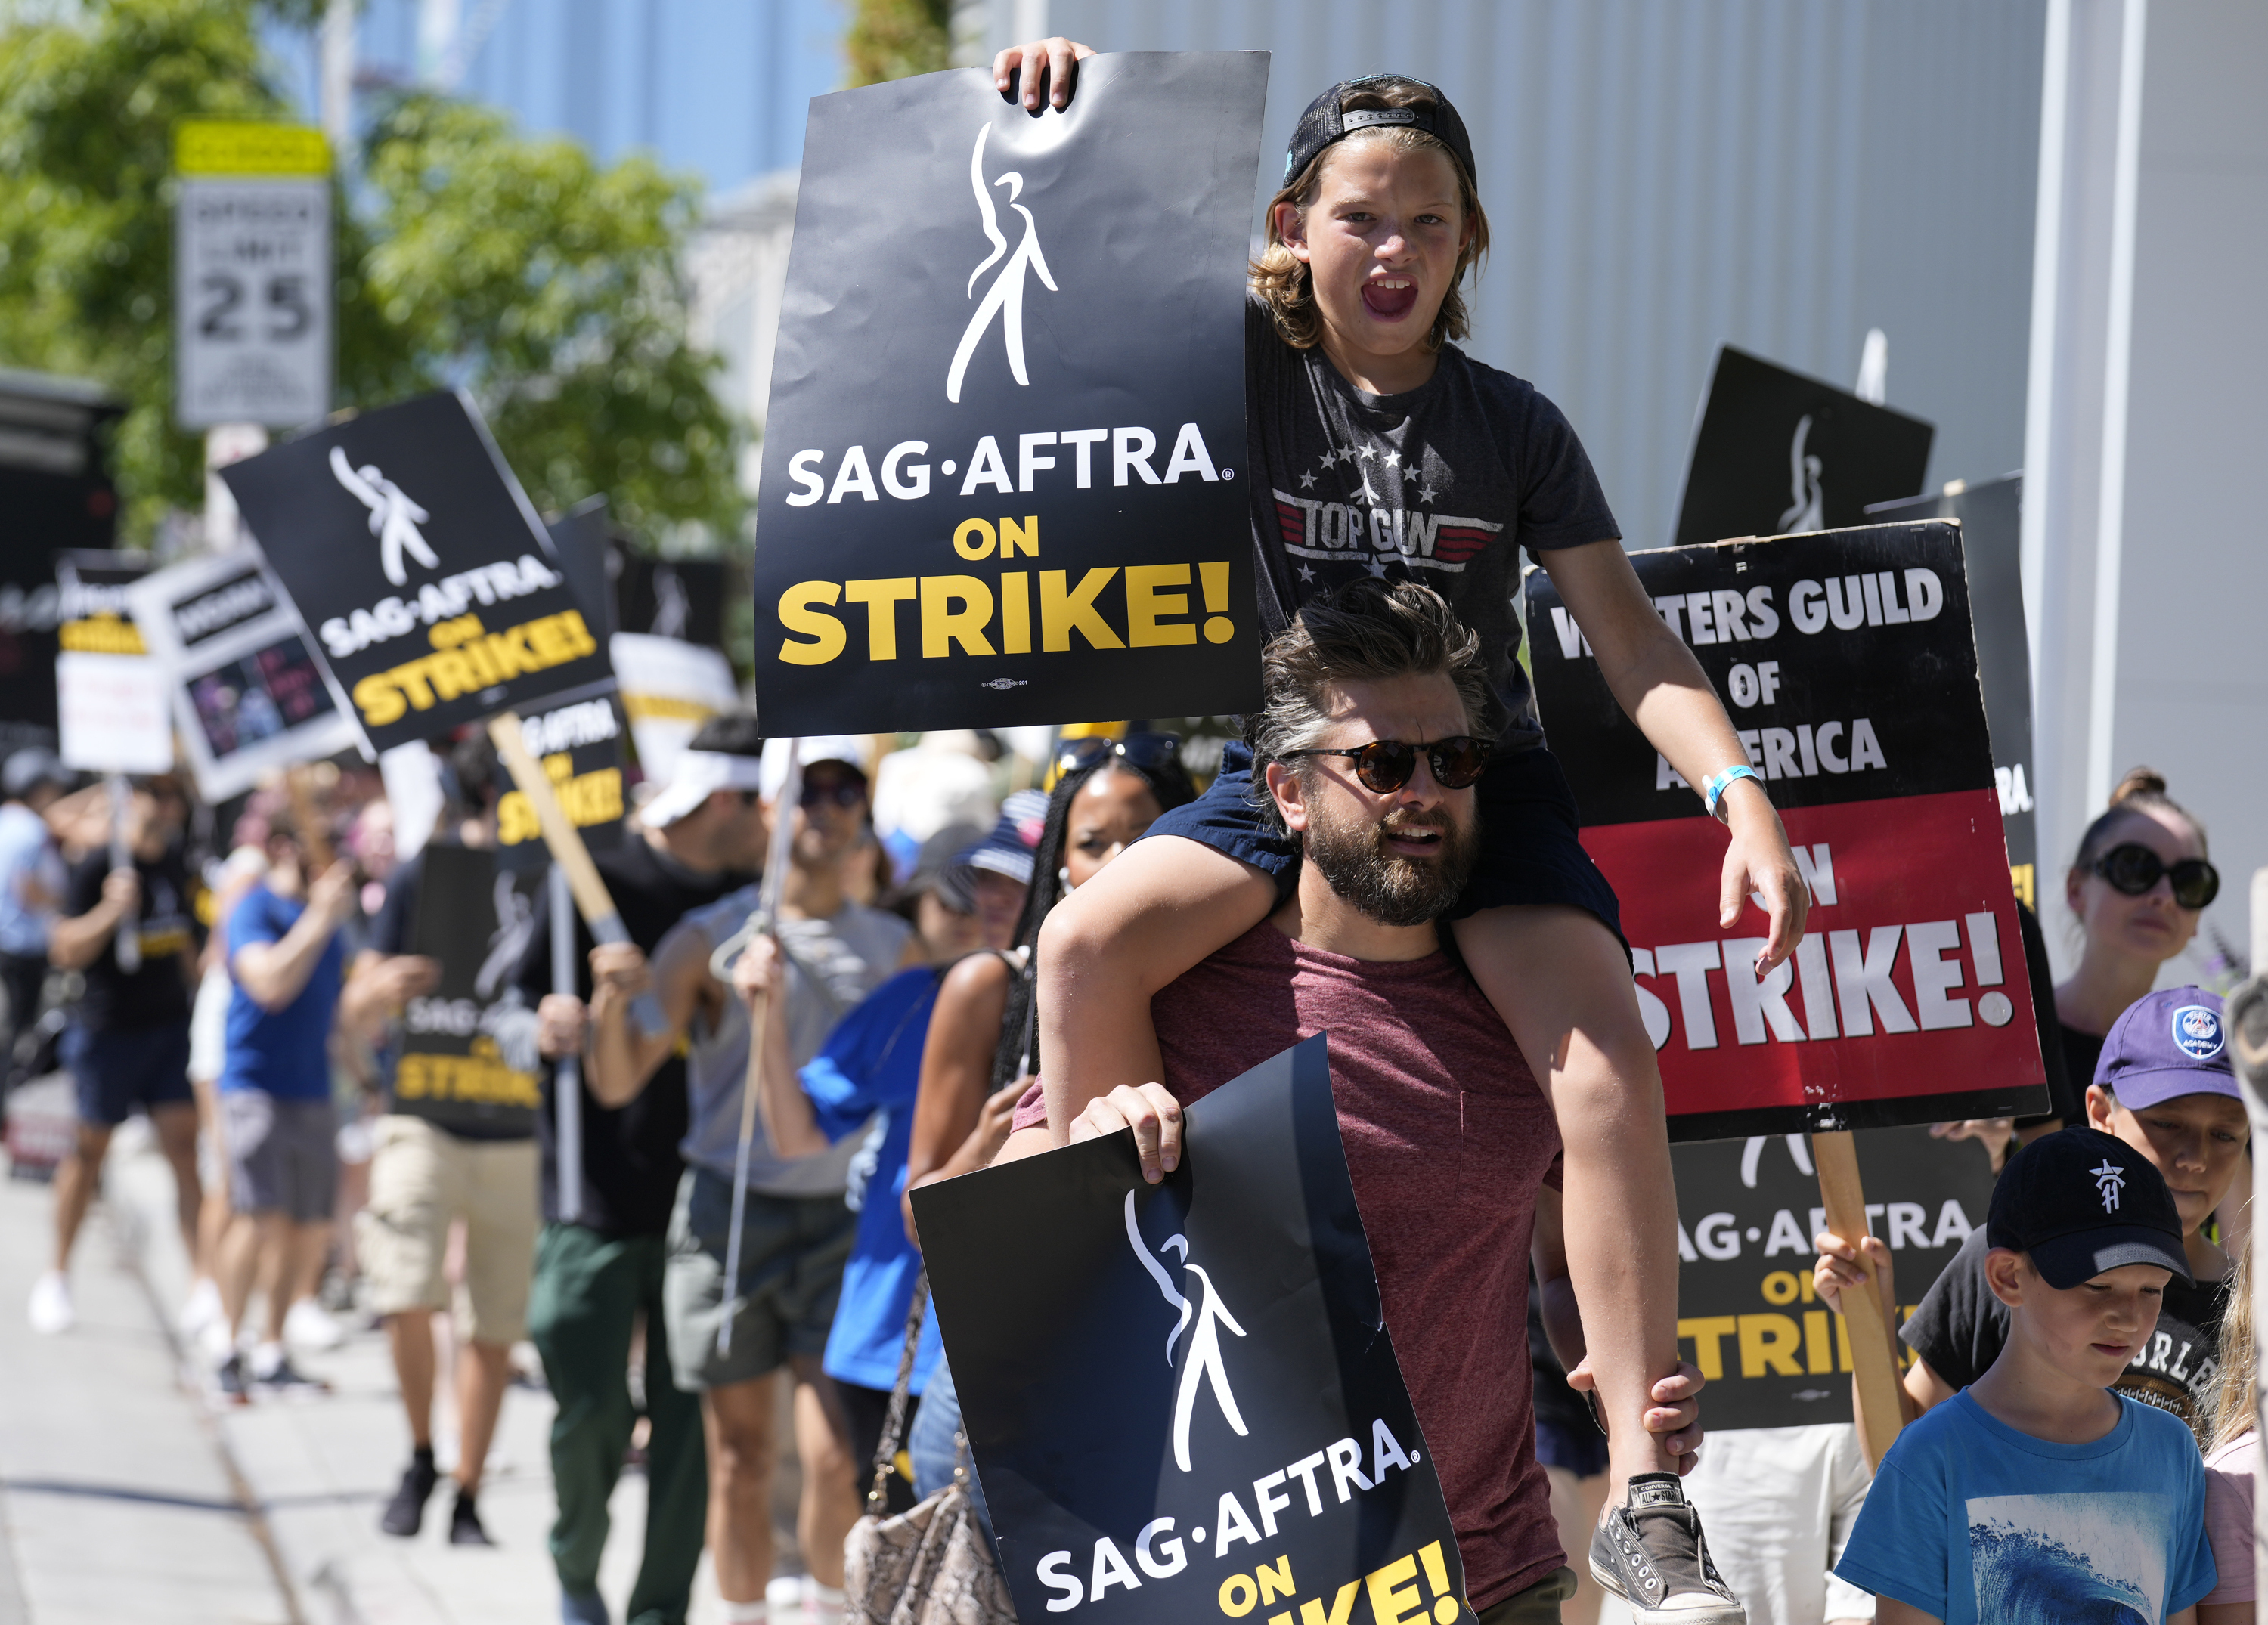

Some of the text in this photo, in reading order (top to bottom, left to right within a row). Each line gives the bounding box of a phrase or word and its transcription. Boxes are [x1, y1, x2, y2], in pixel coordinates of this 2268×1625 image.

[199, 274, 312, 341] 25
[953, 515, 1039, 561] ON
[1294, 497, 1439, 557] TOP GUN
[428, 612, 485, 651] ON
[778, 561, 1235, 666] STRIKE!
[1550, 568, 1944, 660] WTERS GUILD
[352, 609, 596, 726] STRIKE!
[1728, 661, 1780, 708] OF
[1656, 717, 1888, 791] AERICA
[1633, 911, 2015, 1052] STRIKE!
[2183, 1039, 2218, 1050] ACADEMY
[1641, 1492, 1653, 1504] ALL
[1218, 1554, 1297, 1617] ON
